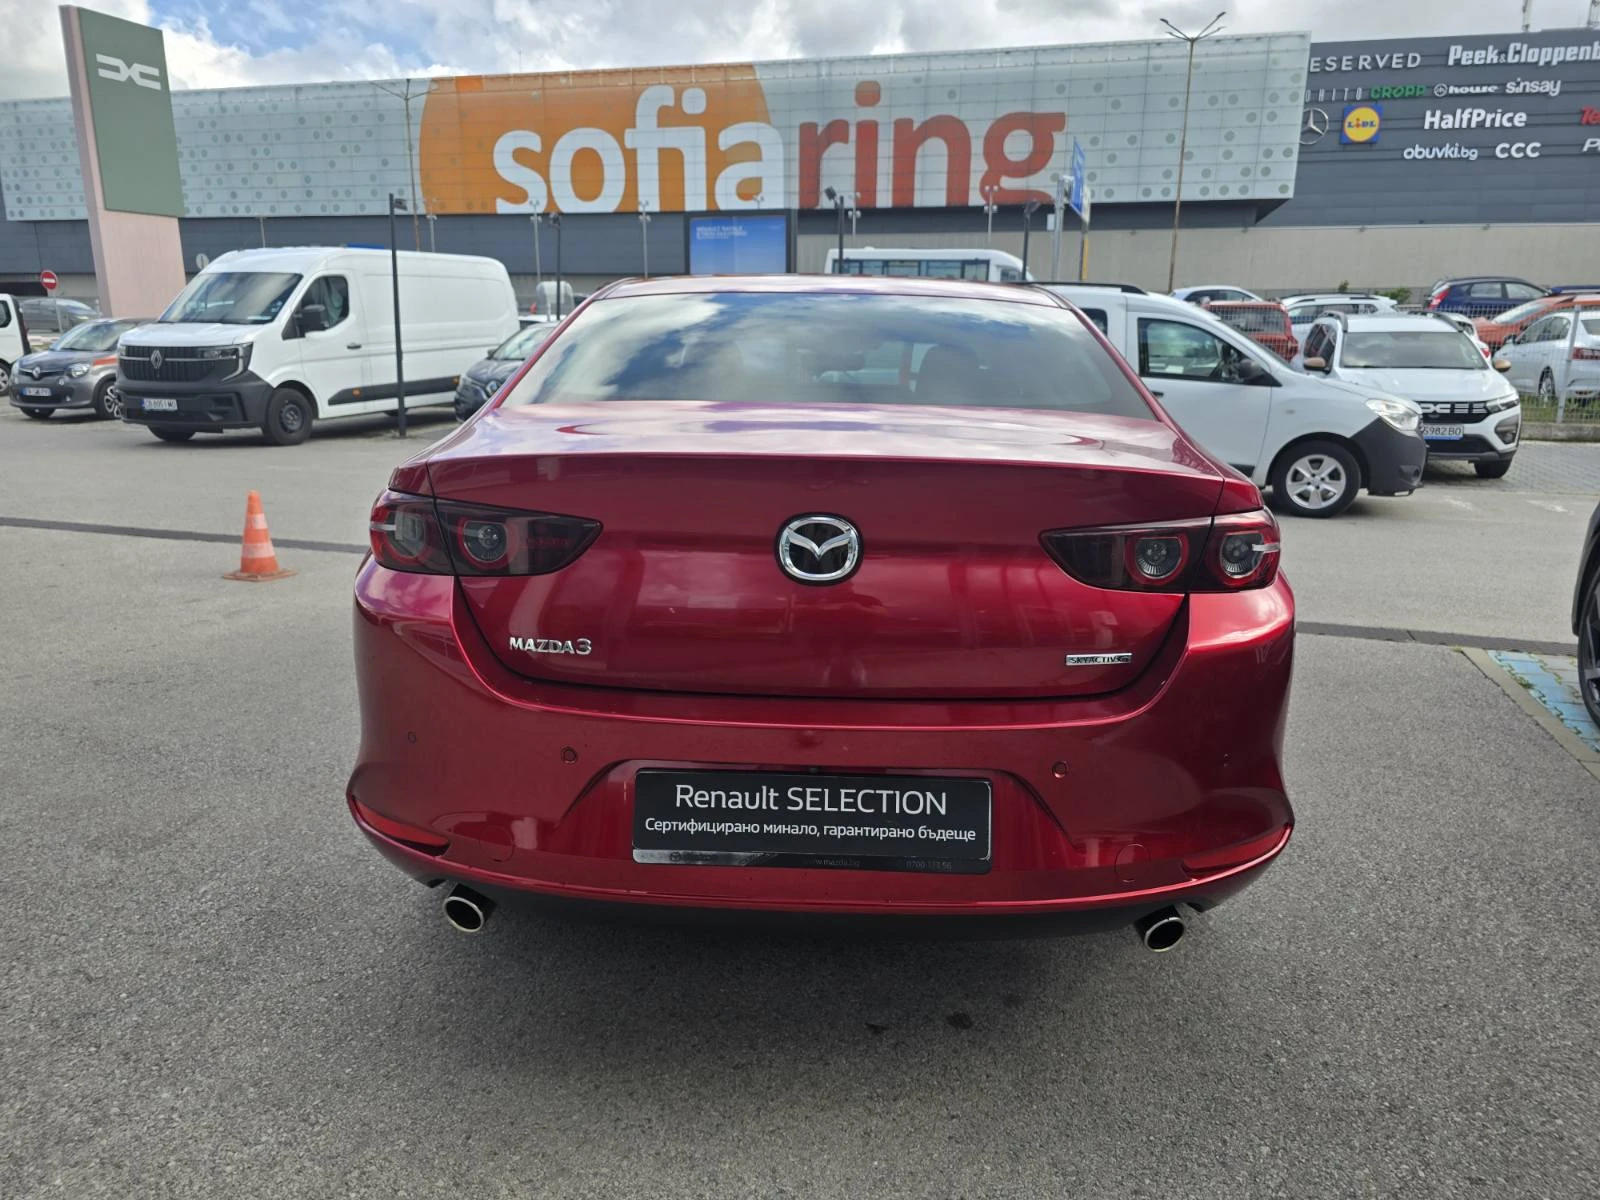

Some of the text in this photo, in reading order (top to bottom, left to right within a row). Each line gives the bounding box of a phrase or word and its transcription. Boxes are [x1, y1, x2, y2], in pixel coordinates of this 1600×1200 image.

[1370, 84, 1426, 99] CROPP
[1423, 108, 1528, 130] HalfPrice
[1403, 143, 1478, 160] obuvki.bg
[1495, 142, 1541, 158] CCC
[675, 784, 947, 816] Renault SELECTION
[645, 817, 977, 842] Сертифицирано минало, гарантирано бъдеще
